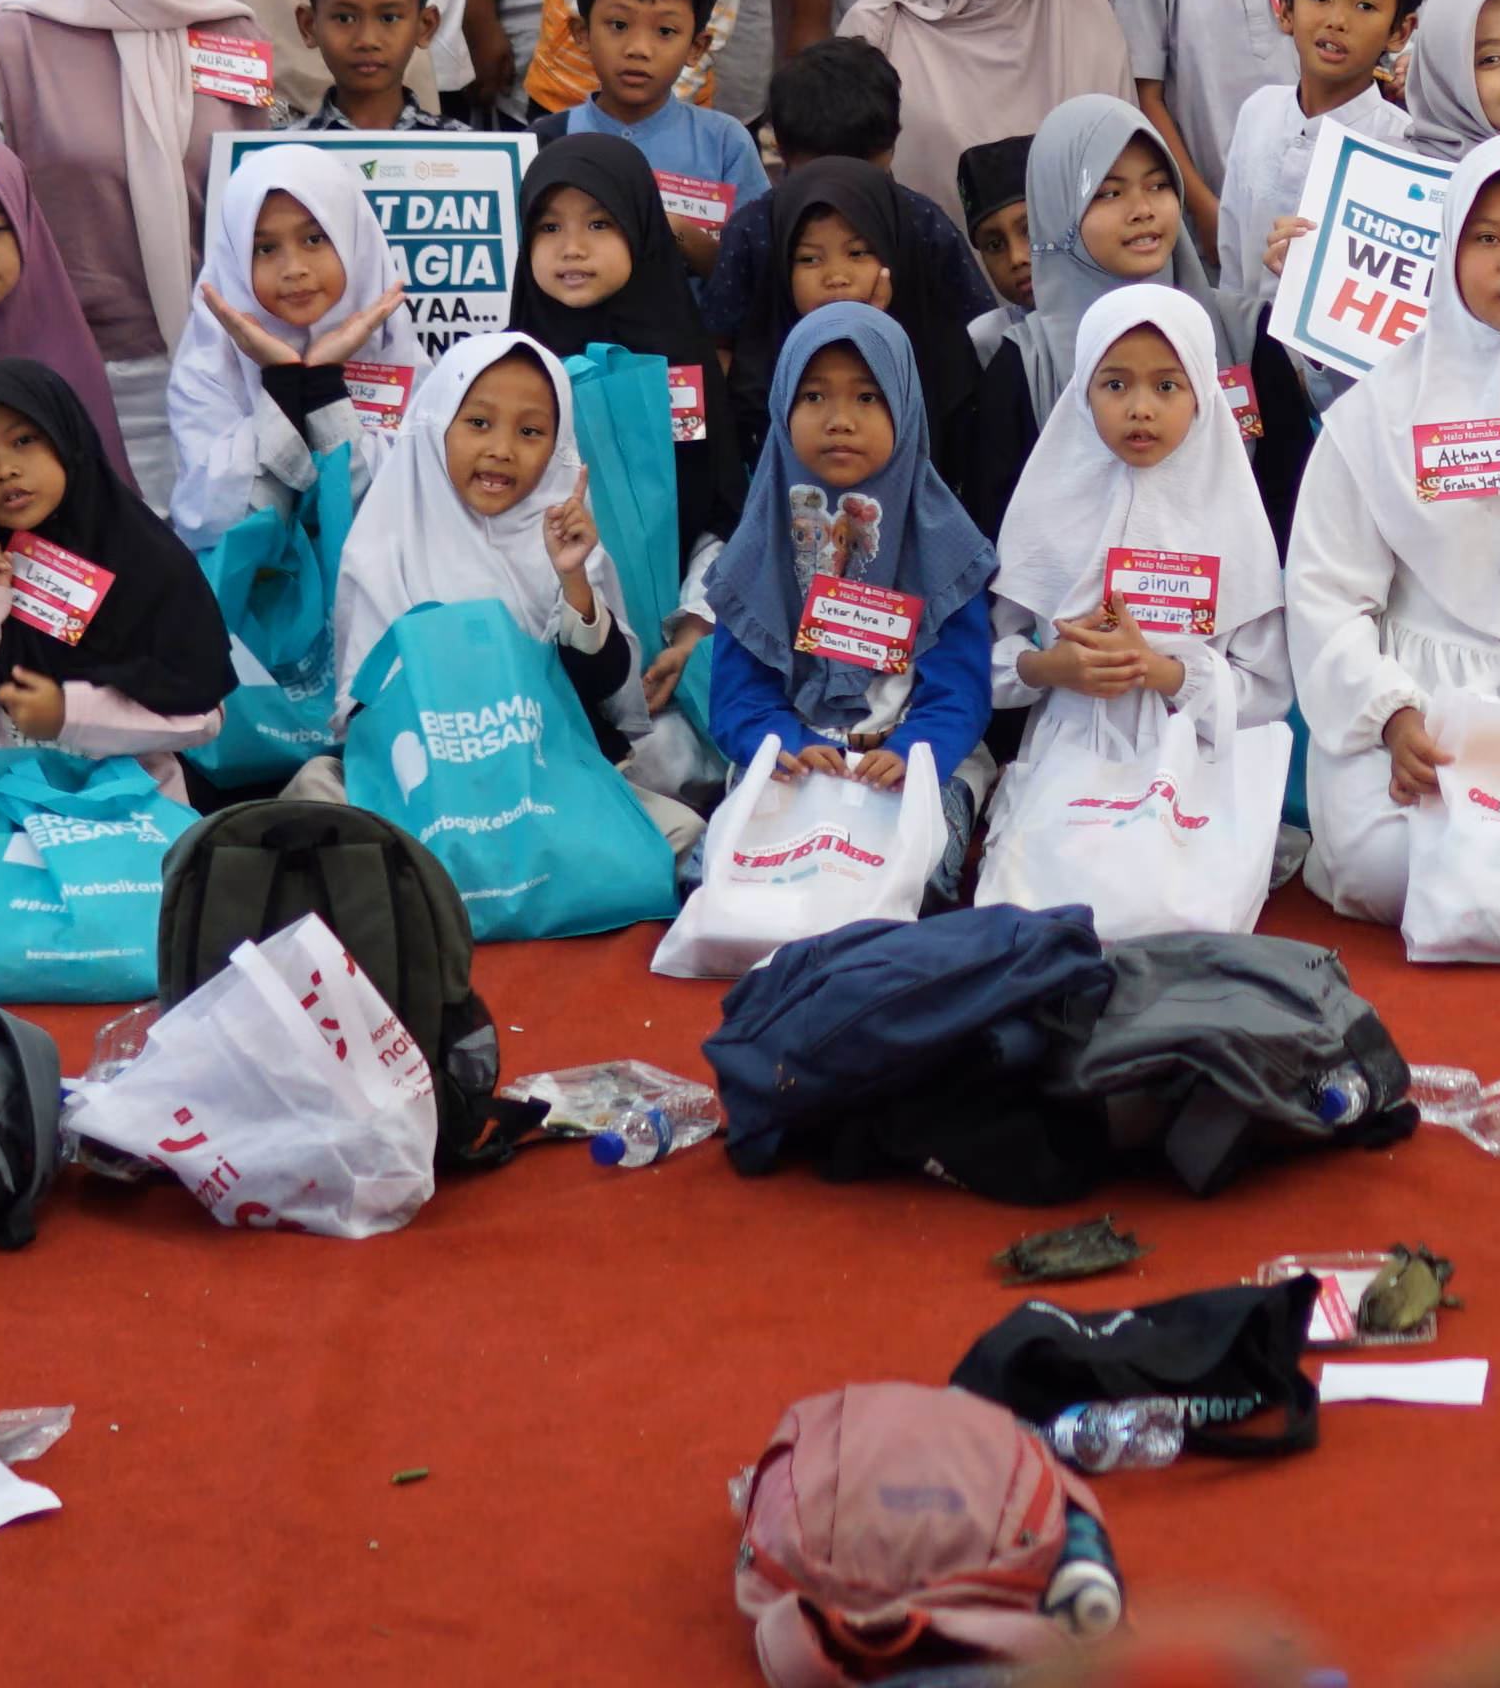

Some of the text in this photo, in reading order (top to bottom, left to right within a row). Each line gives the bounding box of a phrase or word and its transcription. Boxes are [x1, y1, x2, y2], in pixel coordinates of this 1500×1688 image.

[406, 195, 490, 230] DAN
[1347, 237, 1418, 291] WE
[1443, 429, 1500, 442] Halo Namaku
[1135, 559, 1191, 573] Halo Namaku
[25, 562, 71, 606] Lintang
[1137, 572, 1190, 596] ainun
[839, 590, 894, 615] Halo Namaku
[852, 609, 879, 628] Ayra
